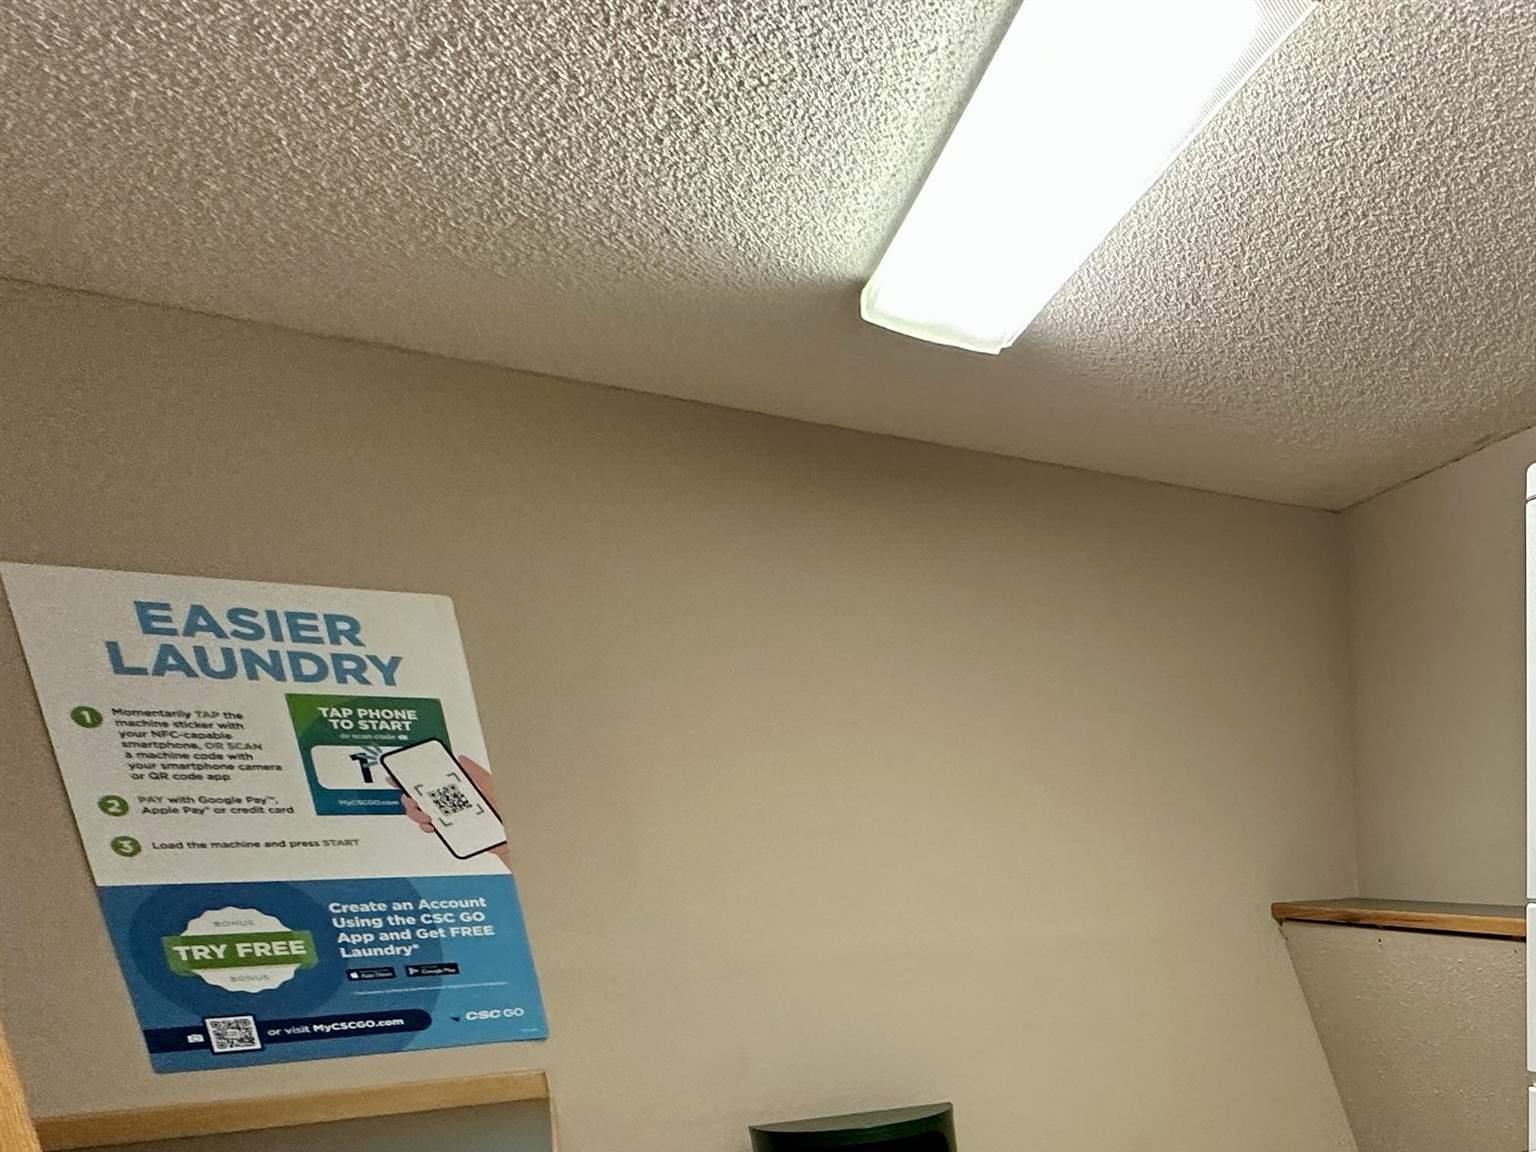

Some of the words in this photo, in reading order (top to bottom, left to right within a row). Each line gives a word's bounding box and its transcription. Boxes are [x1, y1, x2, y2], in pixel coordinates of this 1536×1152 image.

[134, 600, 365, 647] EASIER
[105, 641, 403, 687] LAUNDRY
[82, 709, 92, 724] 1
[112, 708, 191, 719] Momentarily
[194, 710, 220, 718] TAP
[223, 712, 243, 720] the
[318, 707, 353, 719] TAP
[357, 708, 418, 720] PHONE
[115, 720, 169, 728] machine
[173, 721, 214, 729] sticker
[217, 722, 244, 730] with
[328, 719, 354, 729] TO
[357, 720, 412, 731] START
[118, 731, 147, 739] your
[150, 730, 232, 740] NFC-capable
[122, 741, 202, 750] smartphone,
[204, 742, 224, 750] OR
[227, 742, 263, 750] SCAN
[136, 752, 190, 760] machine
[193, 752, 224, 760] code
[128, 763, 156, 771] your
[160, 762, 235, 771] smartphone
[350, 753, 374, 783] 1
[148, 772, 169, 781] QR
[106, 800, 120, 813] 2
[168, 796, 195, 804] with
[198, 796, 242, 805] Google
[142, 806, 180, 815] Apple
[230, 806, 264, 814] credit
[268, 806, 294, 814] card
[118, 839, 133, 853] 3
[152, 841, 183, 849] Load
[187, 841, 207, 849] the
[211, 840, 260, 848] machine
[265, 840, 286, 848] and
[289, 840, 320, 848] press
[322, 839, 360, 847] START
[328, 901, 388, 913] Create
[392, 901, 414, 911] an
[418, 897, 487, 910] Account
[332, 915, 383, 929] Using
[387, 914, 416, 925] the
[420, 913, 456, 924] CSC
[459, 911, 486, 922] GO
[337, 932, 375, 944] App
[379, 929, 412, 941] and
[416, 928, 446, 939] Get
[450, 925, 496, 937] FREE
[172, 944, 227, 960] TRY
[235, 940, 307, 958] FREE
[465, 1009, 501, 1021] CSC
[504, 1007, 525, 1018] GO
[284, 1026, 311, 1035] visit
[313, 1018, 404, 1033] MyCSCGO.com
